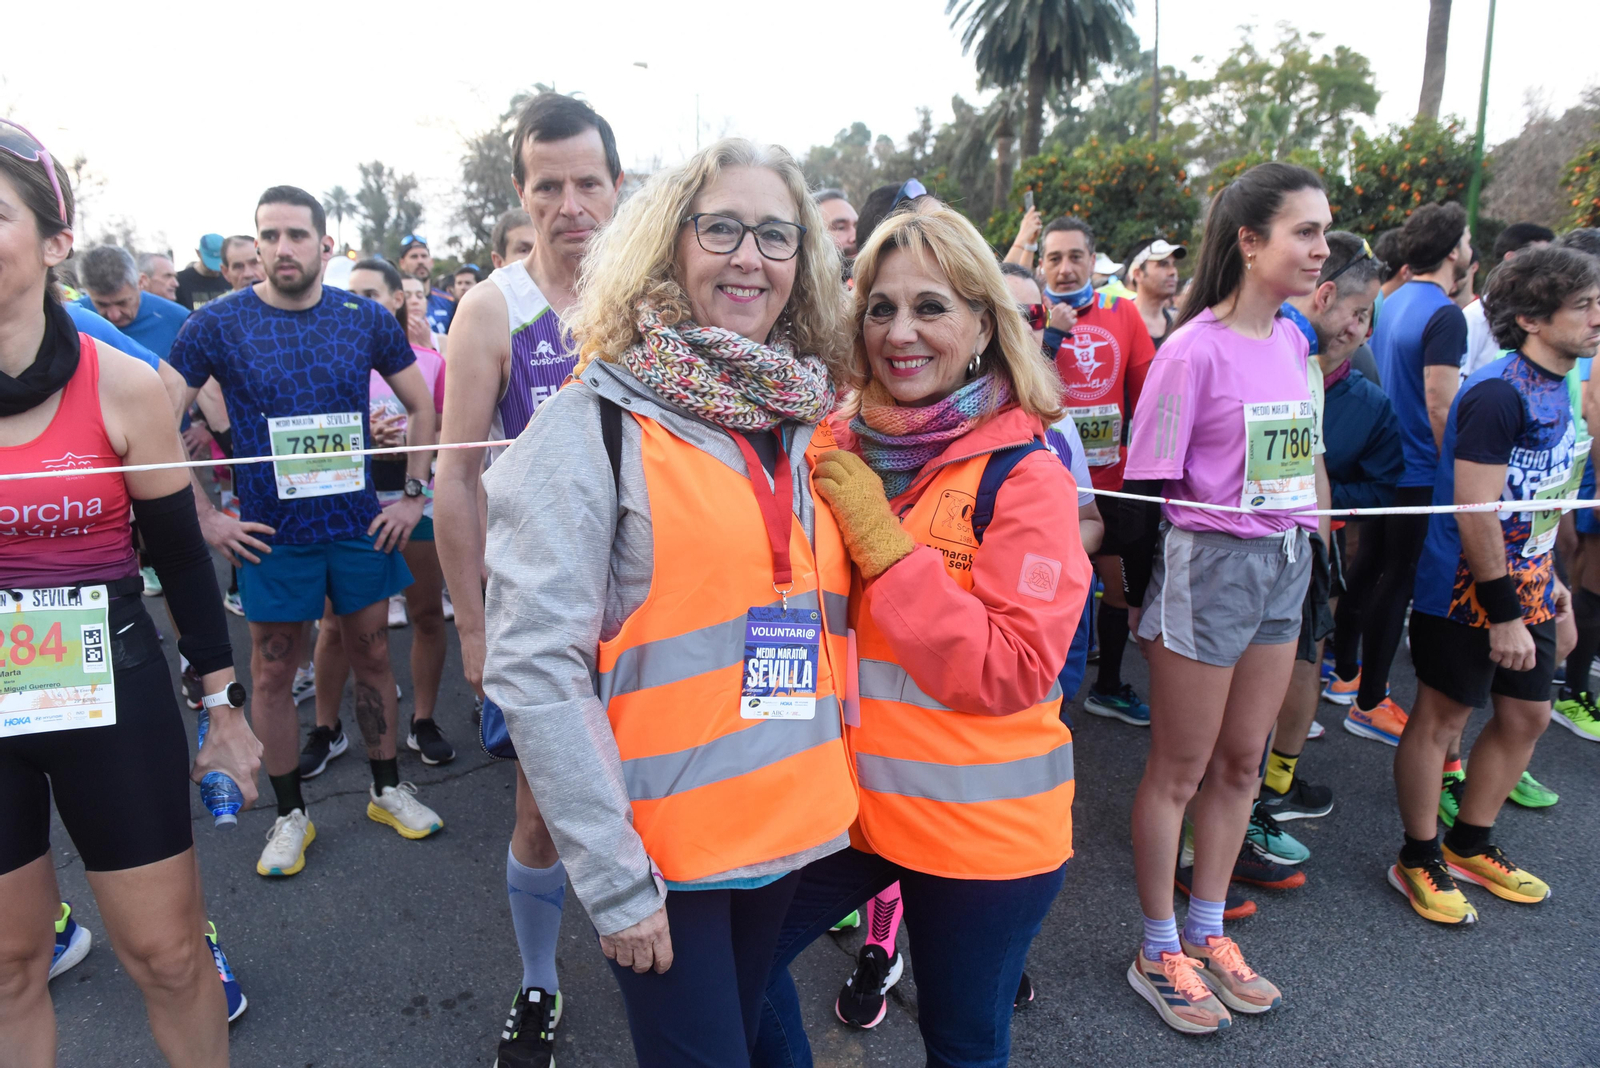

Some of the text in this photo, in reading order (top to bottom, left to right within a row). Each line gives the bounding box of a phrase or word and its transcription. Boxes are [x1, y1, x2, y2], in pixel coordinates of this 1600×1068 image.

[326, 414, 351, 425] SEVILLA
[287, 433, 345, 455] 7878
[1263, 427, 1311, 461] 7780
[751, 626, 816, 640] VOLUNTARI@
[755, 646, 808, 660] MEDIO MARATÓN
[747, 658, 812, 688] SEVILLA
[4, 685, 27, 693] Miguel
[29, 682, 61, 691] Guerrero
[4, 716, 31, 727] HOKA
